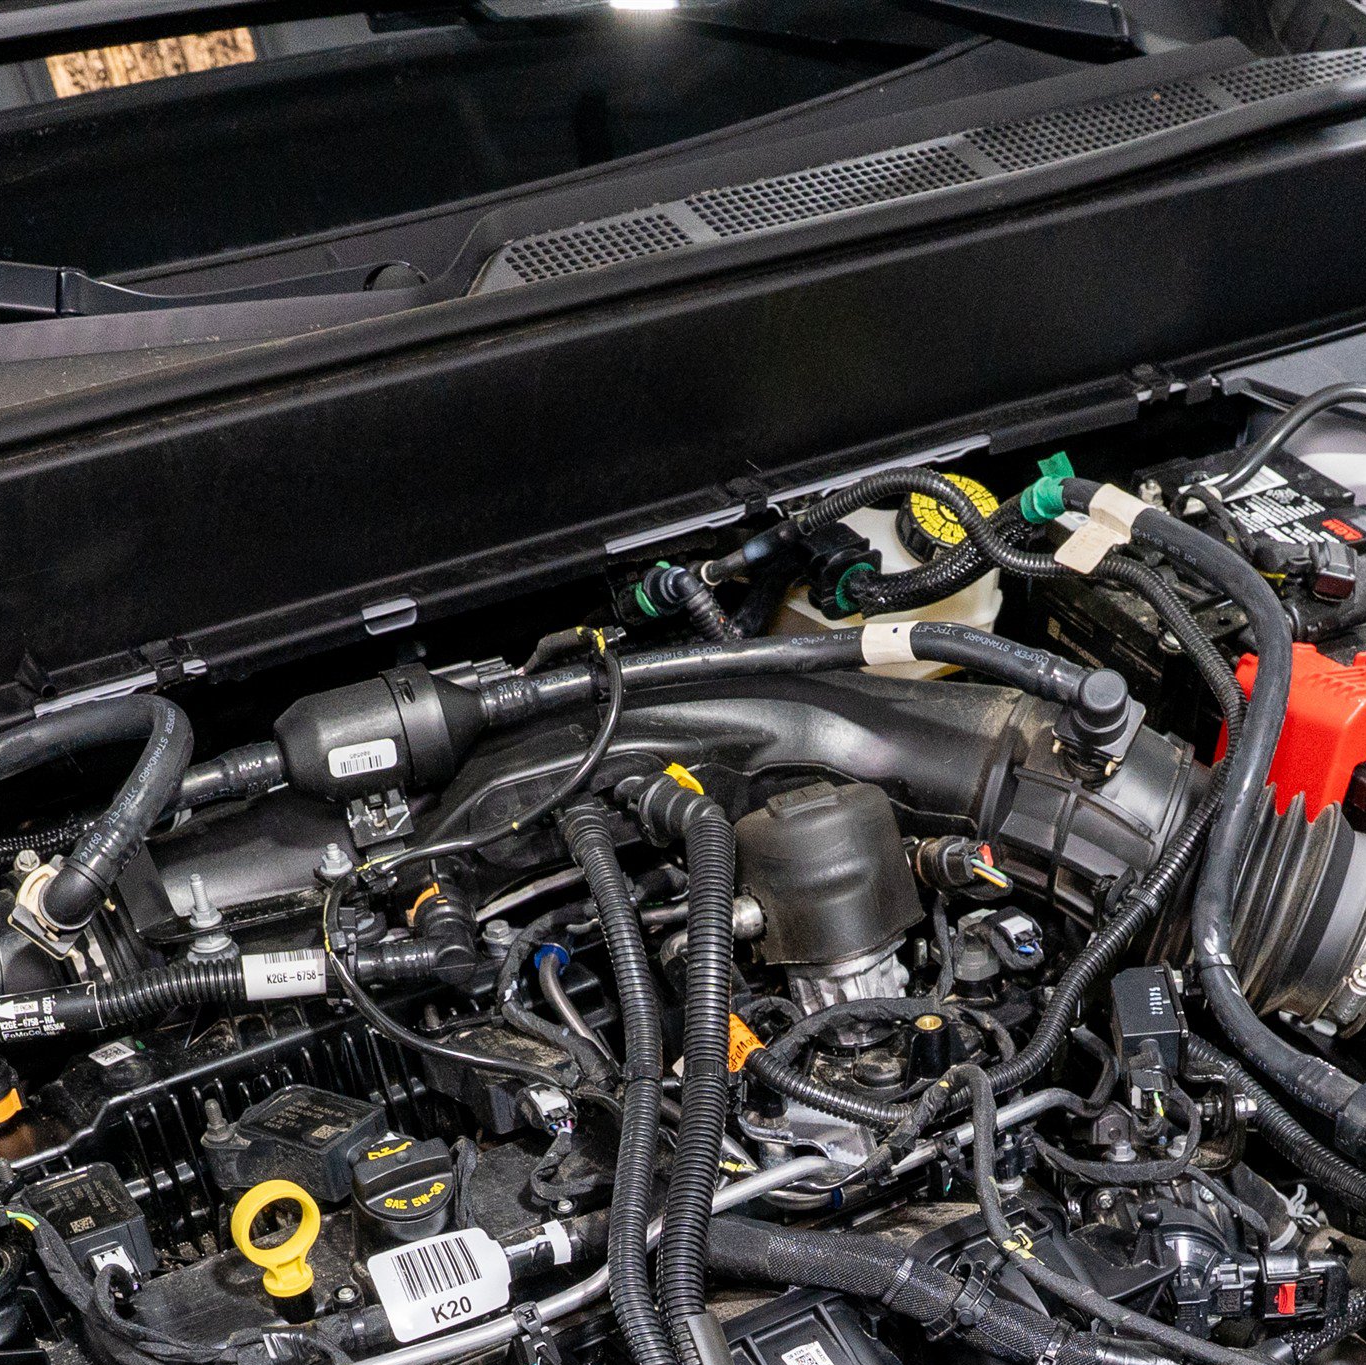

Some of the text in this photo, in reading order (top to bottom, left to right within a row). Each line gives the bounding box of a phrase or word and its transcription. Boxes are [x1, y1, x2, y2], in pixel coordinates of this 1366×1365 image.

[962, 629, 1010, 651] STANDARD
[636, 645, 721, 663] COOPER STANDARD
[1014, 647, 1049, 665] COOPER
[138, 737, 170, 784] STANDARD
[383, 1181, 446, 1212] SAE 5W-30
[431, 1296, 473, 1325] K20
